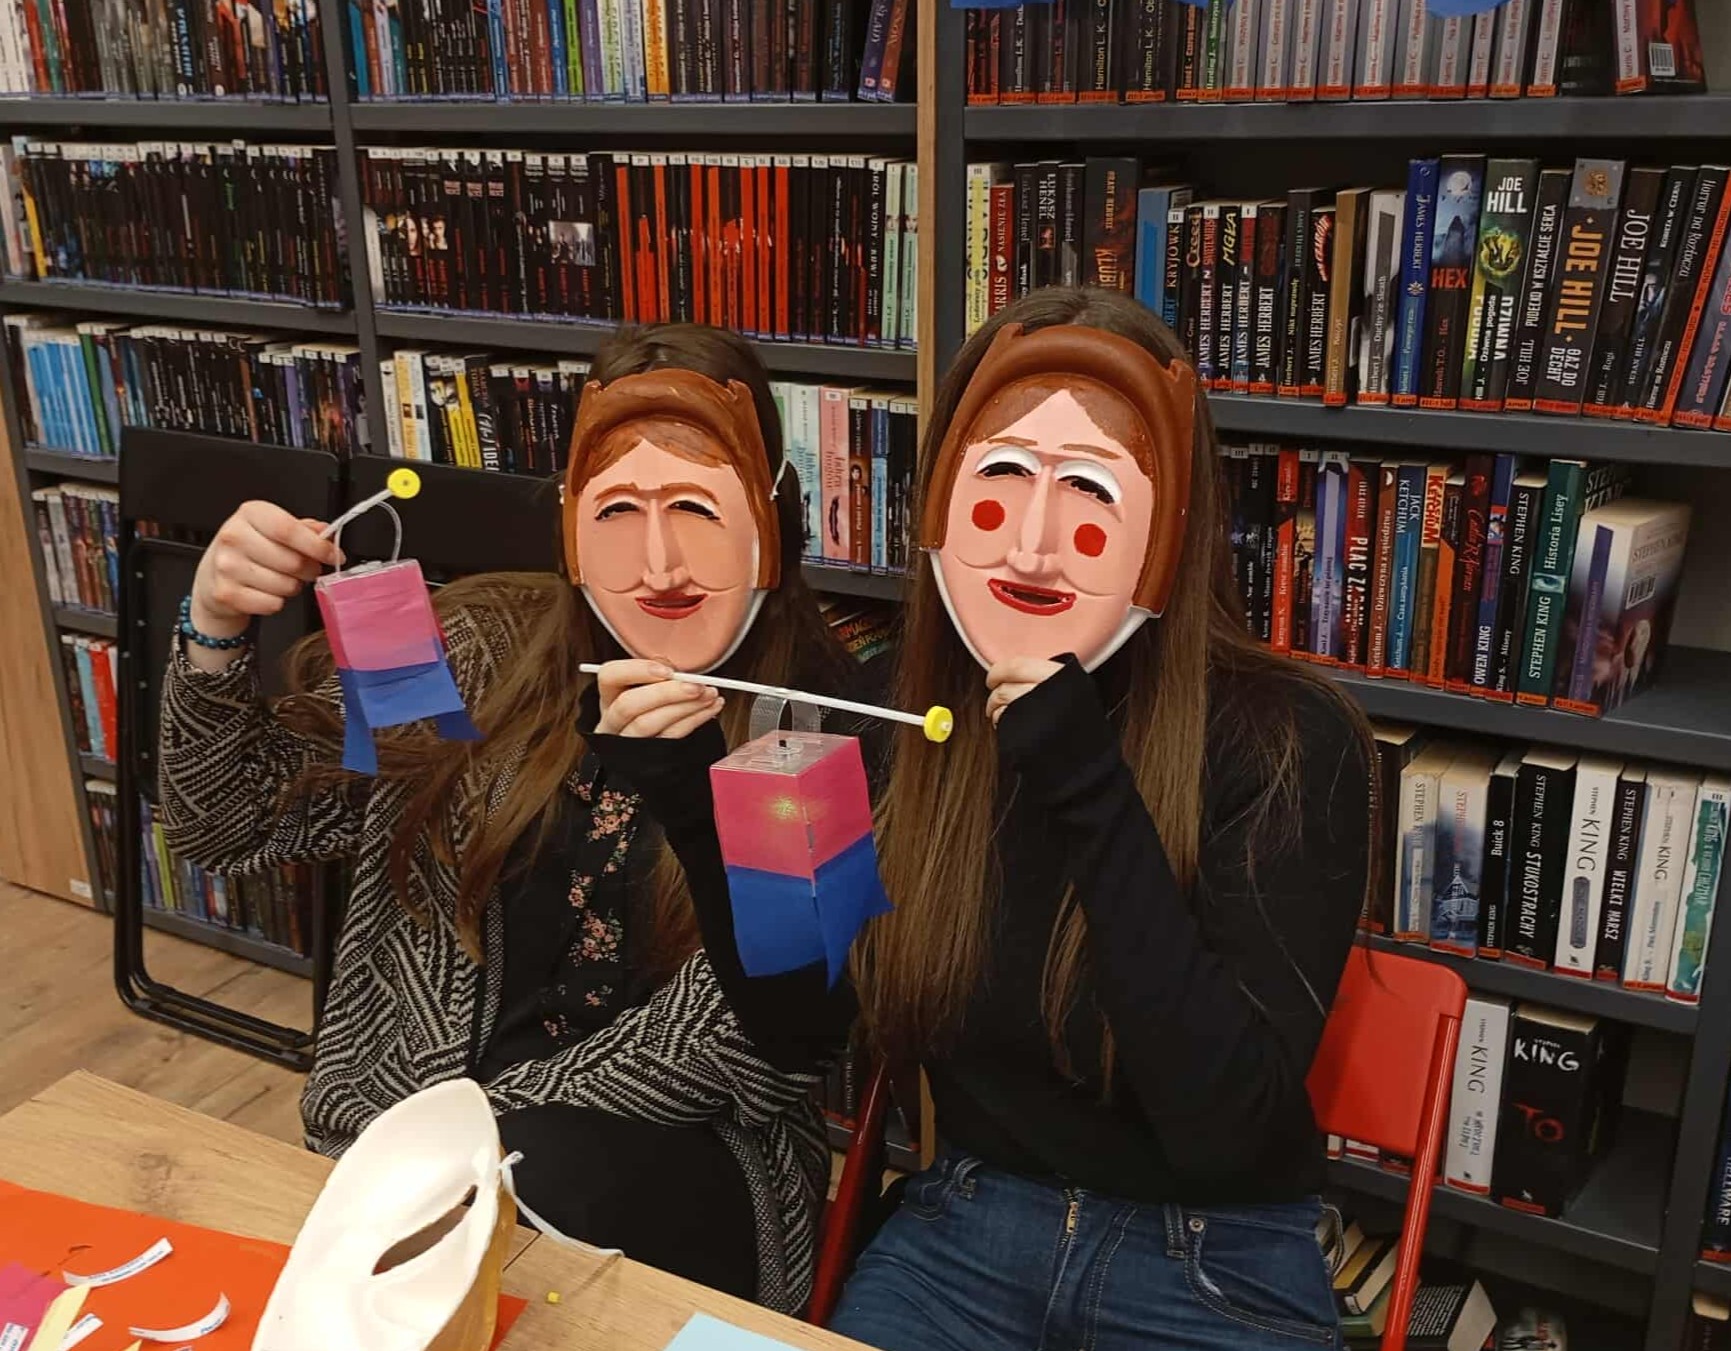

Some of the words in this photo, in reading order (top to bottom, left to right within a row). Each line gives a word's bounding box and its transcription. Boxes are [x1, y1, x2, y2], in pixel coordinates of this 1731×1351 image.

[1095, 47, 1105, 90] Hamilton
[1143, 51, 1153, 90] Hamilton
[1038, 180, 1047, 220] HENEL
[1498, 176, 1523, 193] JOE
[1694, 178, 1717, 215] Horror
[1415, 194, 1431, 231] JAMES
[1486, 191, 1528, 215] HILL
[1540, 203, 1558, 232] SERCA
[1222, 212, 1236, 266] MGŁA
[1621, 209, 1652, 250] JOE
[1690, 216, 1703, 231] na
[1412, 232, 1424, 270] HERBERT
[1533, 234, 1553, 280] KSZTAŁCIE
[1564, 224, 1603, 273] JOE
[993, 276, 1007, 313] ARRIS
[1431, 265, 1468, 290] HEX
[1532, 279, 1544, 290] W
[1609, 254, 1641, 304] HILL
[1200, 282, 1212, 330] HERBERT
[1219, 283, 1233, 332] HERBERT
[1237, 279, 1250, 328] HERBERT
[1258, 286, 1274, 332] HERBERT
[1310, 290, 1326, 338] HERBERT
[1525, 291, 1544, 328] PUDEŁKO
[1554, 278, 1595, 335] HILL
[1374, 315, 1384, 343] Duchy
[1480, 329, 1492, 362] Dziwna
[1486, 296, 1497, 327] pogoda
[1633, 336, 1645, 357] HILL
[1199, 335, 1211, 368] JAMES
[1219, 334, 1230, 369] JAMES
[1237, 330, 1249, 365] JAMES
[1256, 334, 1271, 369] JAMES
[1307, 337, 1322, 372] JAMES
[1519, 338, 1536, 364] HILL
[1545, 346, 1565, 382] DECHY
[1601, 352, 1615, 371] Rogi
[1514, 364, 1532, 386] JOE
[1561, 370, 1578, 387] DO
[1628, 358, 1641, 385] SUSAN
[1395, 479, 1410, 534] KETCHUM
[1408, 493, 1421, 522] JACK
[1421, 474, 1444, 545] KETCHUM
[1513, 492, 1529, 544] STEPHEN
[1551, 493, 1568, 524] Lisey
[1380, 510, 1392, 555] sąsiedztwa
[1544, 525, 1561, 570] Historia
[1349, 536, 1368, 571] PLAC
[1508, 545, 1523, 576] KING
[1375, 563, 1388, 611] Dziewczyna
[1534, 595, 1551, 625] KING
[1476, 625, 1491, 651] KING
[1500, 629, 1512, 656] Misery
[1529, 627, 1547, 679] STEPHEN
[1474, 652, 1488, 685] OWEN
[1413, 781, 1426, 822] STEPHEN
[1532, 773, 1547, 819] STEPHEN
[1619, 788, 1637, 836] STEPHEN
[1493, 819, 1505, 828] 8
[1530, 821, 1542, 848] KING
[1491, 829, 1504, 857] Buick
[1575, 818, 1601, 872] KING
[1616, 834, 1632, 861] KING
[1654, 845, 1672, 881] KING
[1518, 851, 1543, 939] STUKOSTRACHY
[1609, 869, 1628, 906] WIELKI
[1487, 921, 1496, 948] STEPHEN
[1604, 909, 1622, 941] MARSZ
[1467, 1044, 1490, 1095] KING
[1513, 1037, 1581, 1072] KING
[1512, 1102, 1566, 1143] TO
